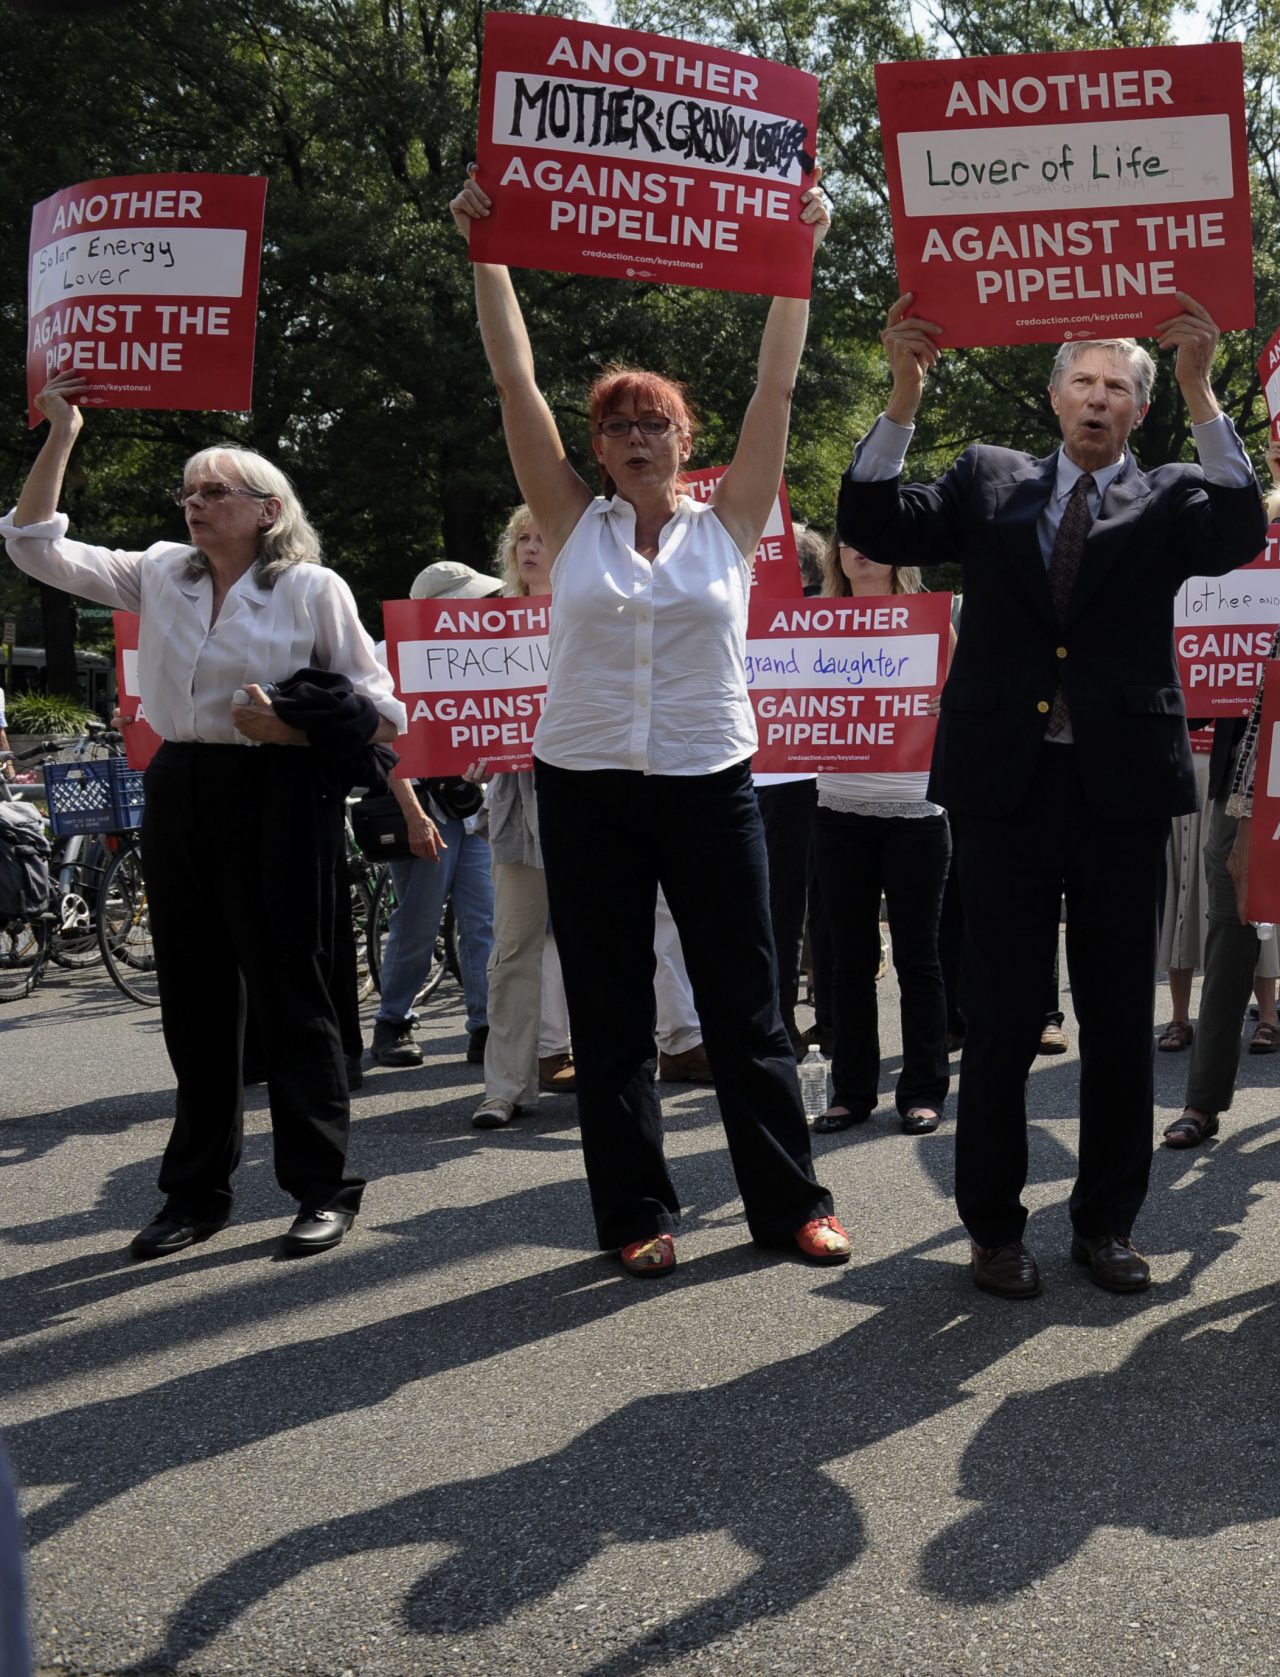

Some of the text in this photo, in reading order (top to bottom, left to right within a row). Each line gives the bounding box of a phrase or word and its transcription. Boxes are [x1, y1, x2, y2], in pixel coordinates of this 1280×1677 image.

[547, 36, 759, 101] ANOTHER
[945, 69, 1174, 118] ANOTHER
[509, 77, 666, 153] MOTHER
[927, 144, 1169, 186] Lover of Life
[500, 156, 791, 222] AGAINST THE
[52, 190, 202, 234] ANOTHER
[550, 200, 739, 252] PIPELINE
[921, 219, 1120, 262] AGAINST
[1136, 212, 1226, 252] THE
[39, 237, 175, 275] Solar Energy
[582, 249, 703, 270] credoaction.com/keystonexl
[63, 267, 131, 290] Lover
[976, 260, 1177, 304] PIPELINE
[32, 304, 231, 353] AGAINST THE
[1015, 311, 1144, 327] credoaction.com/keystonexl
[46, 341, 183, 372] PIPELINE
[434, 606, 551, 633] ANOTH
[769, 607, 909, 632] ANOTHER
[1178, 632, 1275, 658] GAINS
[745, 648, 909, 685] grand daughter
[411, 693, 547, 722] AGAINST
[757, 694, 929, 718] GAINST THE
[450, 722, 534, 748] PIPEL
[767, 723, 895, 745] PIPELINE
